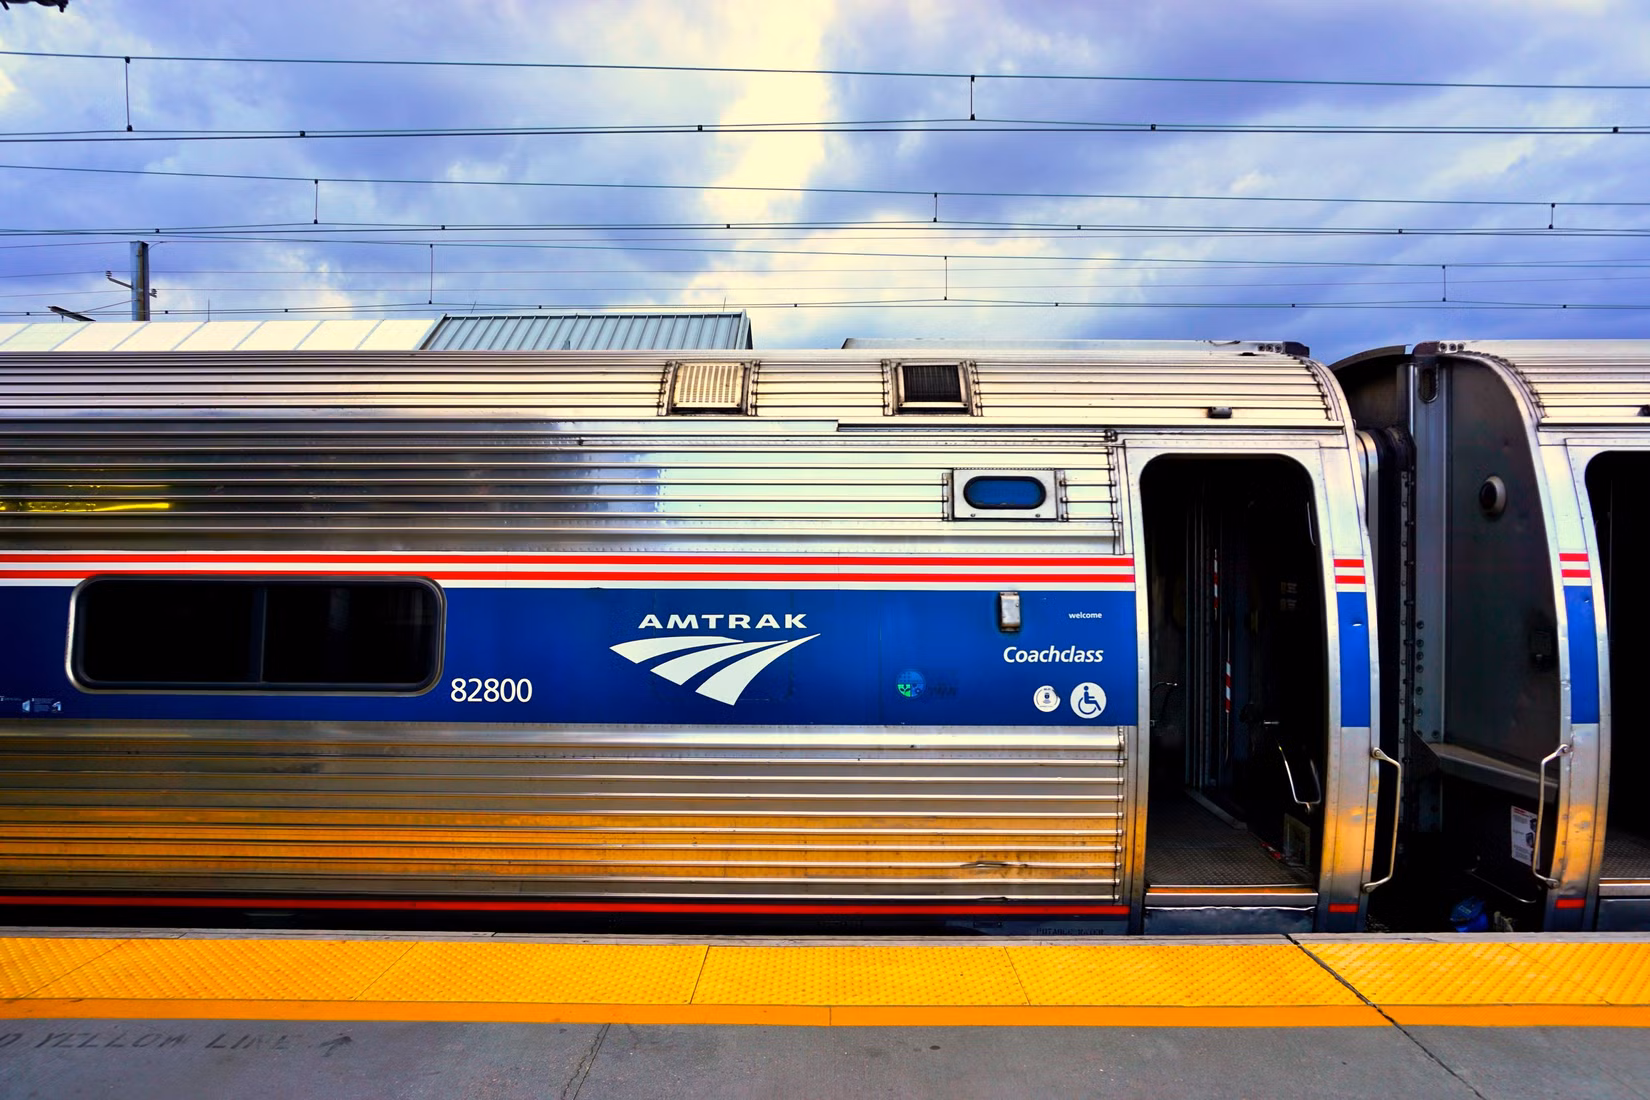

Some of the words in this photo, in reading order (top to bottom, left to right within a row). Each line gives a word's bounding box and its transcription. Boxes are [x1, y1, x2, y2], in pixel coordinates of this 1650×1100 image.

[638, 613, 807, 630] AMTRAK
[1068, 611, 1103, 619] welcome
[1003, 645, 1104, 663] Coachclass
[450, 677, 533, 703] 82800
